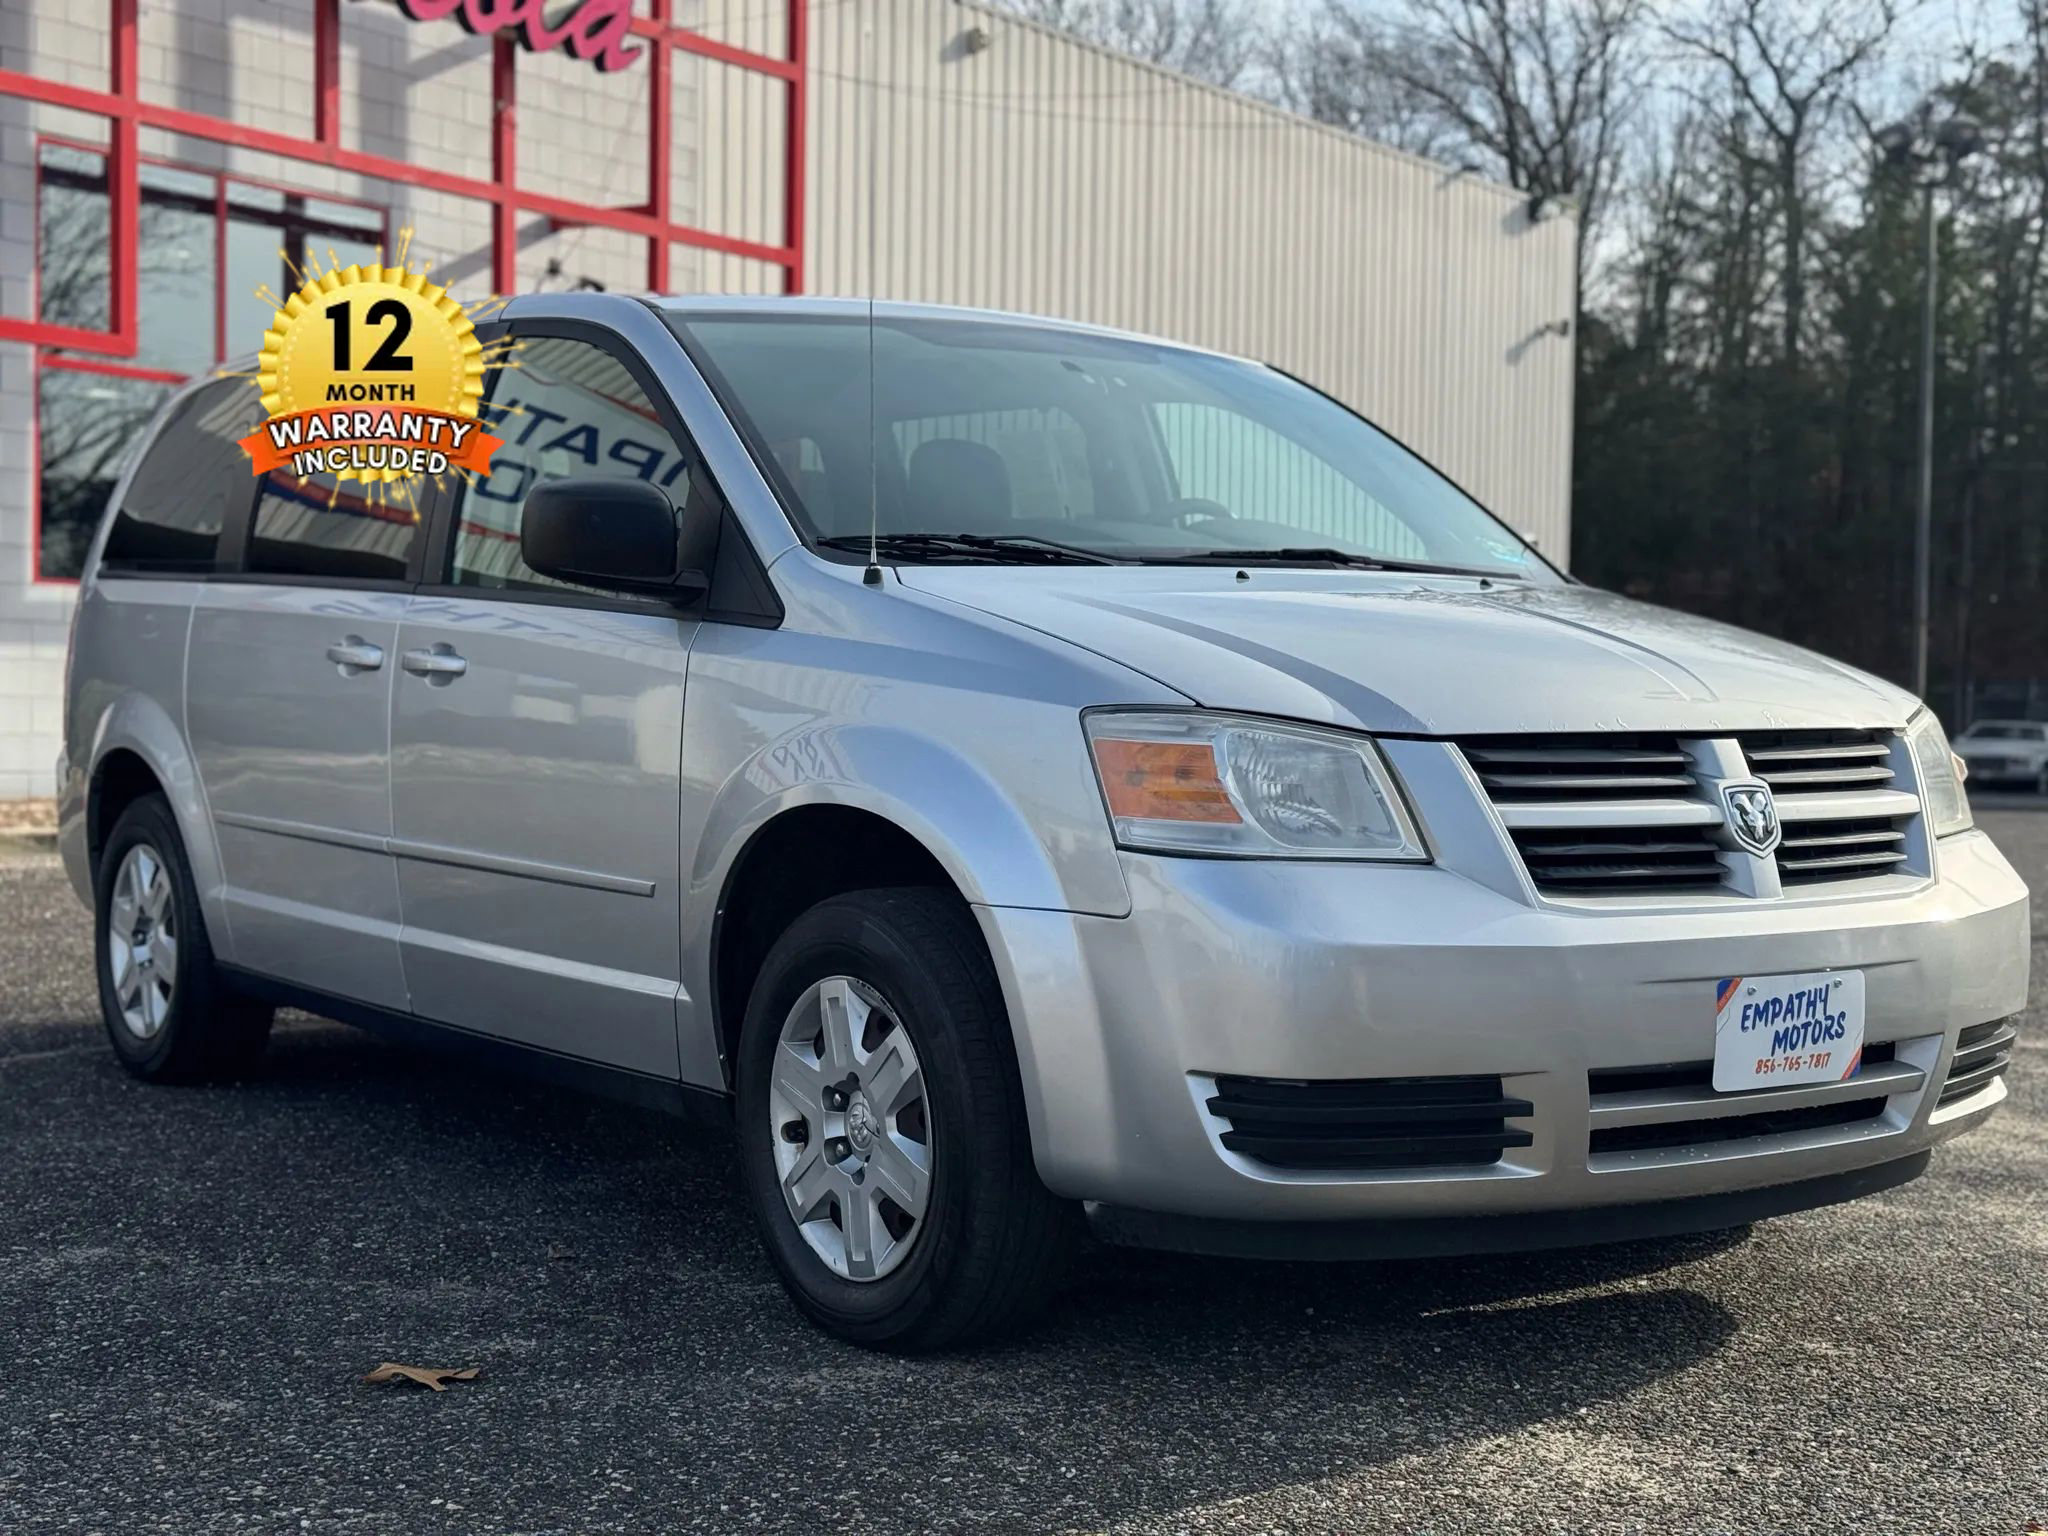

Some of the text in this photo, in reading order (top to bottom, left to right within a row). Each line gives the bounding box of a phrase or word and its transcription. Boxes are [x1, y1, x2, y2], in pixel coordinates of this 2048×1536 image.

[1741, 984, 1830, 1032] EMPATHY
[1771, 1011, 1846, 1056] MOTORS
[1755, 1052, 1831, 1075] 856-765-7817
